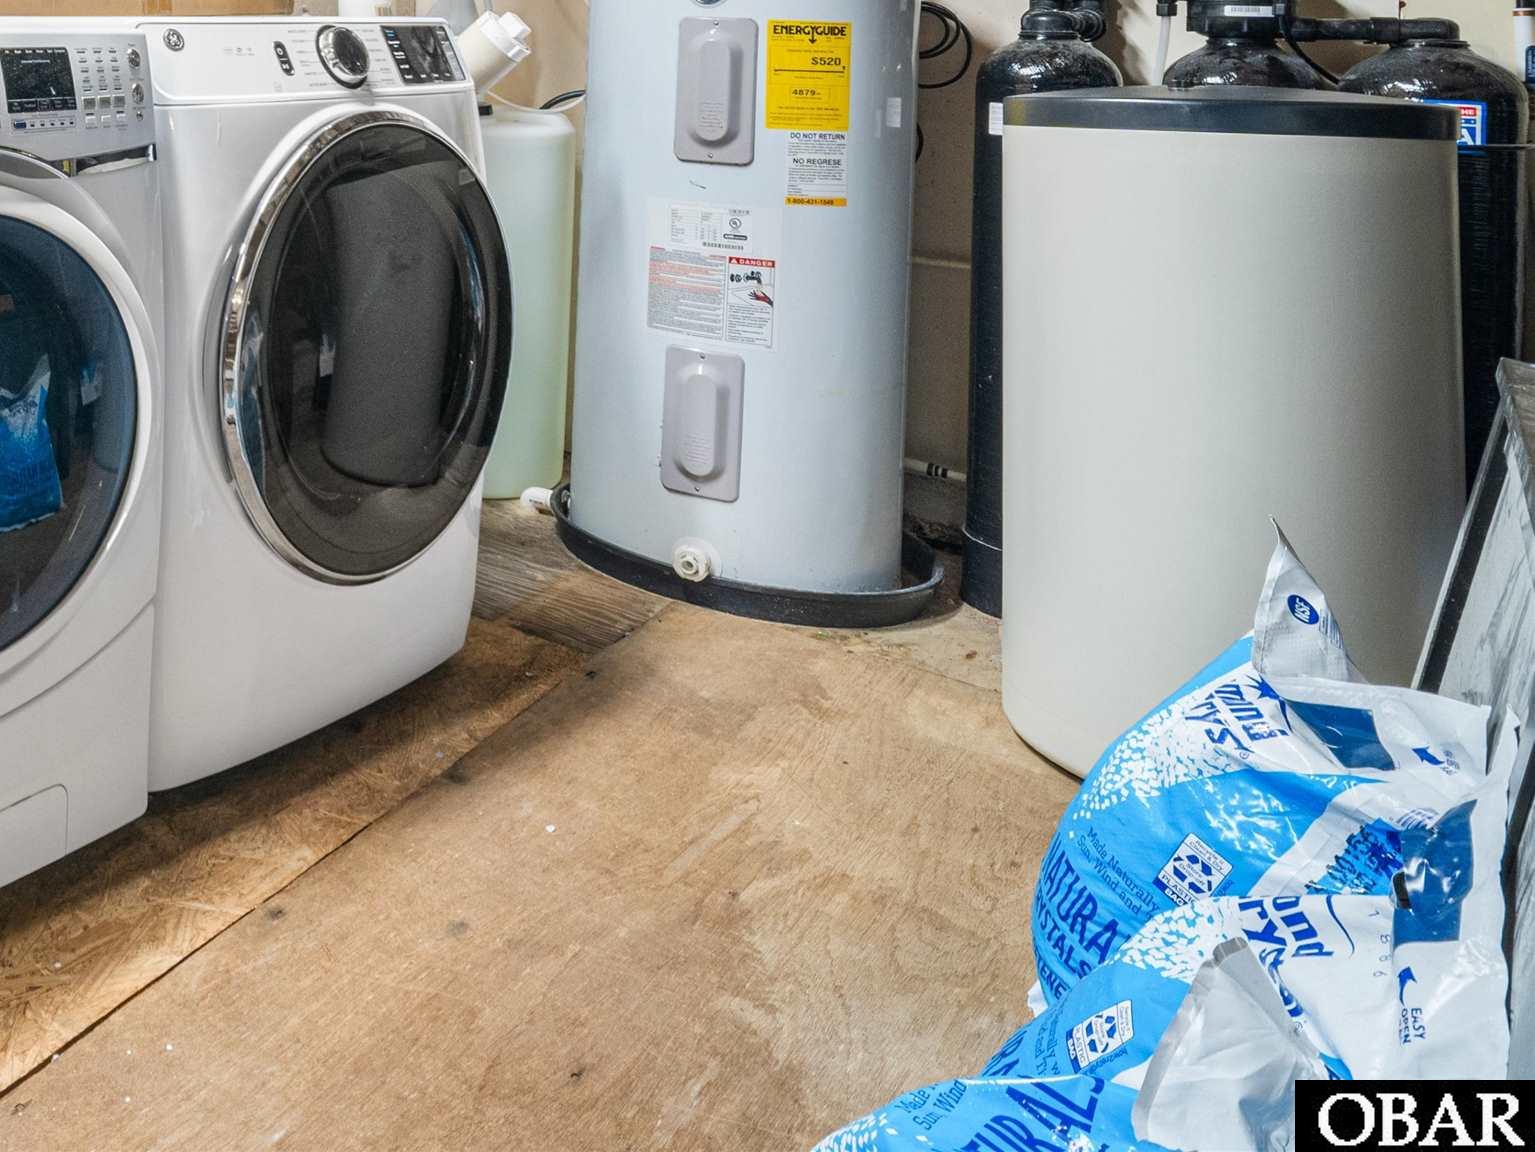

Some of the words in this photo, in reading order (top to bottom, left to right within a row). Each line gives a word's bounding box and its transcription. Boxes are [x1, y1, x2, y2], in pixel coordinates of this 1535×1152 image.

[738, 258, 774, 267] DANGER
[1087, 826, 1108, 859] Made
[1108, 855, 1160, 914] Naturally
[1094, 861, 1118, 890] Wind
[1120, 889, 1143, 916] and
